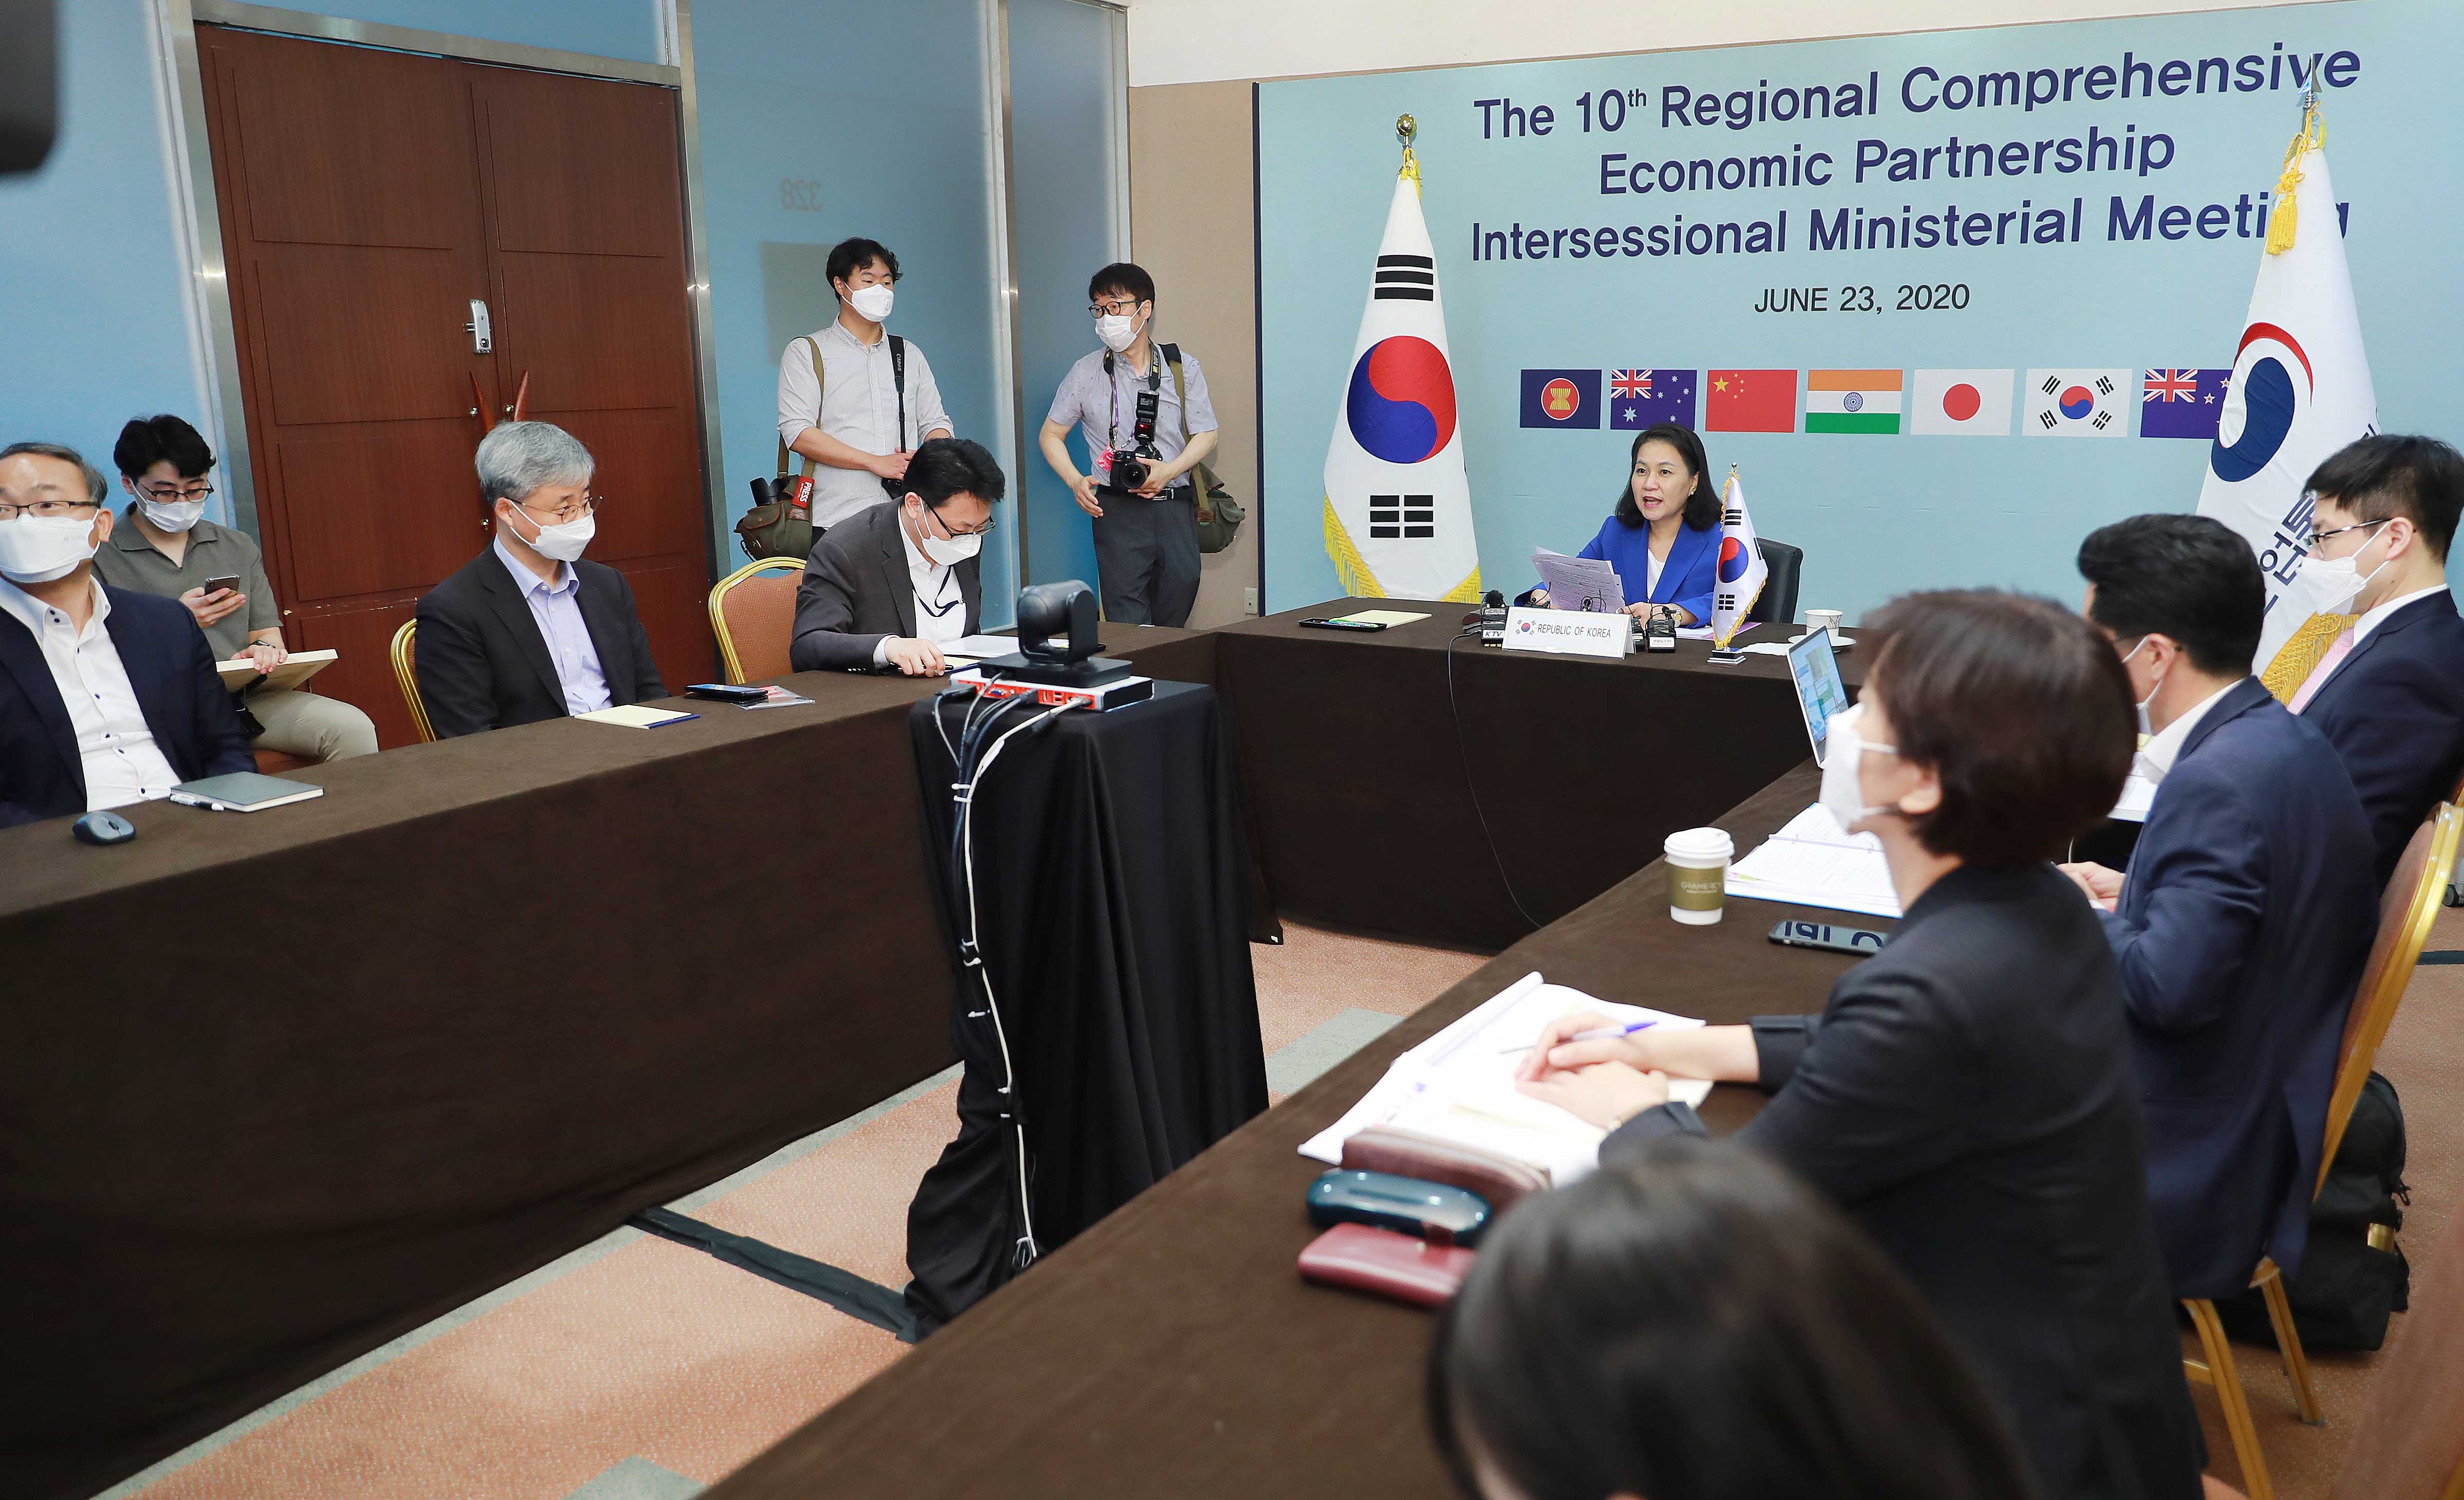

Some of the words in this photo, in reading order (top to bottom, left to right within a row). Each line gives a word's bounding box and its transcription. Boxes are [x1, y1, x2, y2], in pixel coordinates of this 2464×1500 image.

[1473, 98, 1555, 140] The
[1576, 88, 1648, 133] 10th
[1661, 70, 1879, 131] Regional
[1901, 42, 2361, 113] Comprehensive
[1600, 143, 1834, 195] Economic
[1855, 124, 2175, 184] Partnership
[1472, 210, 1787, 261] Intersessional
[1808, 197, 2083, 251] Ministerial
[2107, 191, 2350, 241] Meeti
[1754, 287, 1829, 313] JUNE
[1839, 285, 1883, 315] 23,
[1896, 283, 1970, 311] 2020
[799, 481, 812, 503] PRESS
[1537, 624, 1572, 635] REPUBLIC
[1574, 626, 1584, 636] OF
[1586, 627, 1611, 638] KOREA
